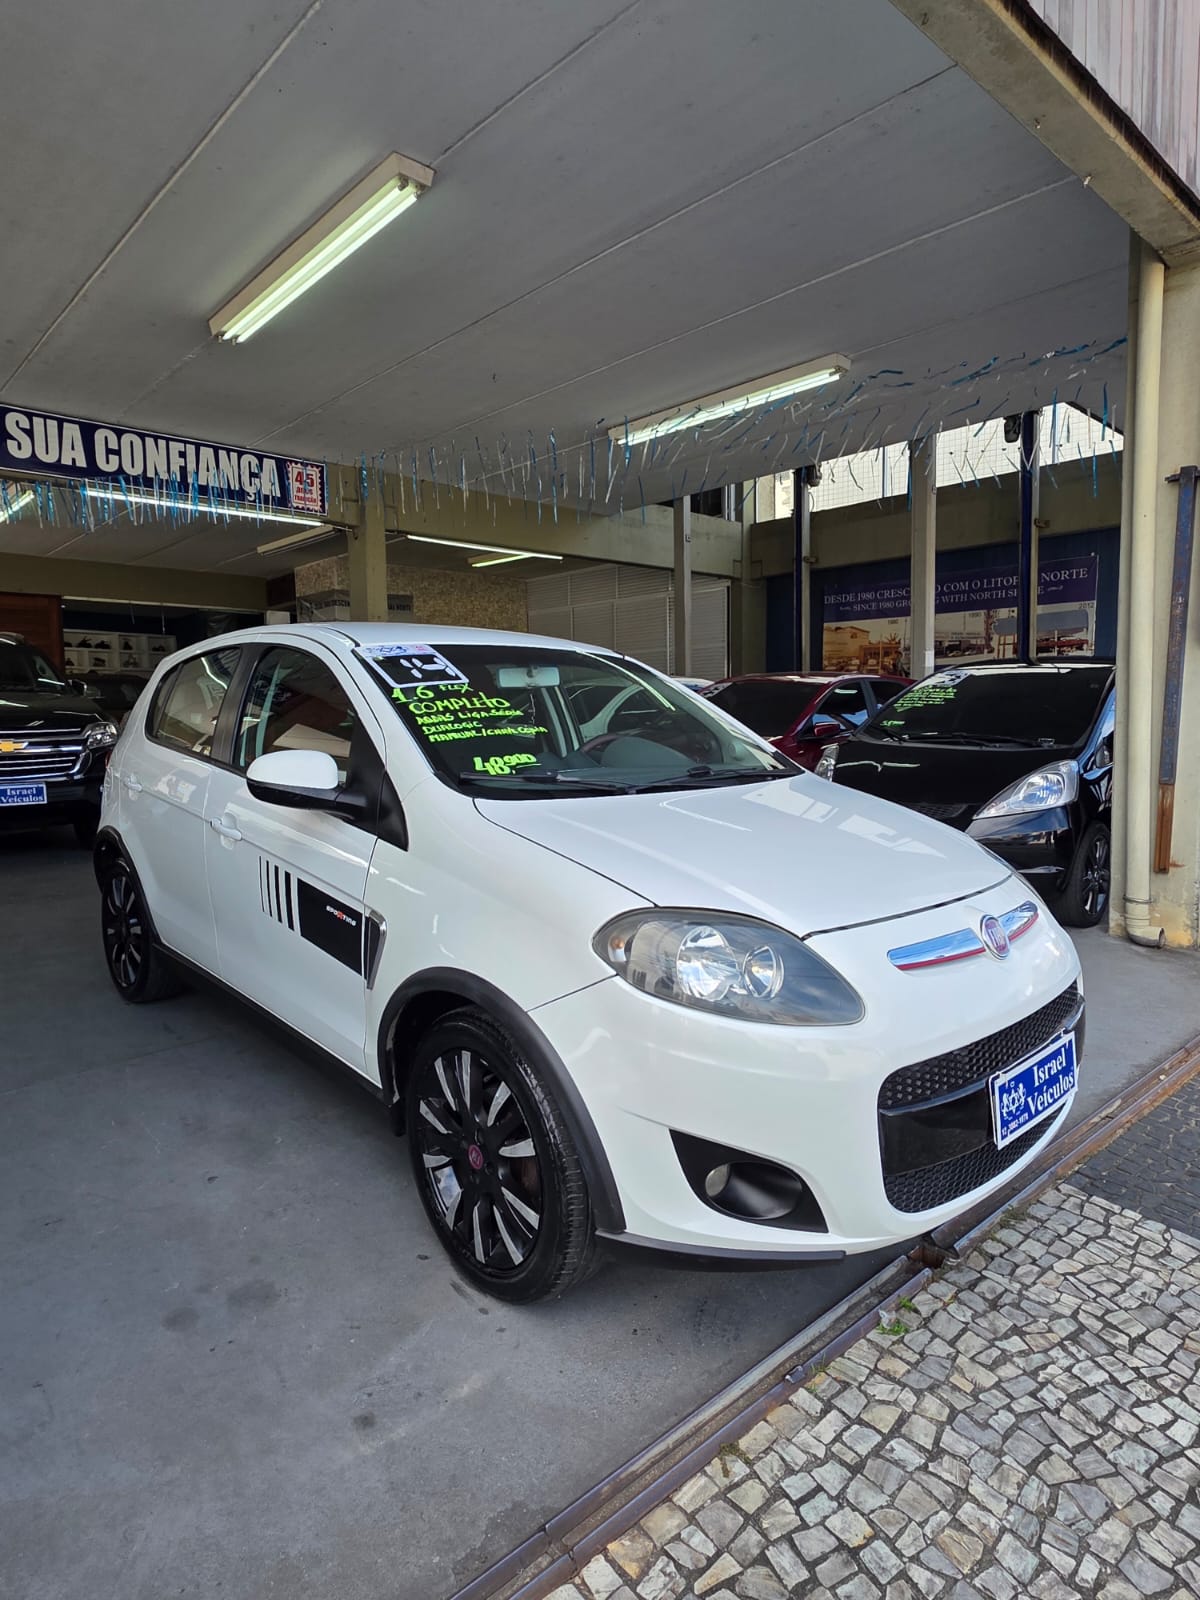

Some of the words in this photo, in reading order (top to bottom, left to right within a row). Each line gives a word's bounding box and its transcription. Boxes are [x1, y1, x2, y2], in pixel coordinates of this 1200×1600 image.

[4, 411, 87, 468] SUA
[94, 428, 281, 500] CONFIANÇA
[295, 471, 315, 488] 45
[824, 592, 856, 605] DESDE
[857, 591, 876, 602] 1980
[943, 580, 969, 592] COM
[972, 579, 981, 590] O
[1041, 567, 1089, 583] NORTE
[853, 602, 877, 612] SINCE
[879, 601, 895, 609] 1980
[940, 594, 968, 604] WITH
[969, 590, 1006, 601] NORTH
[391, 685, 435, 703] 1.6
[408, 691, 511, 714] COMPLETO
[1, 795, 44, 803] Veículos
[7, 787, 37, 796] Israel
[1033, 1047, 1067, 1087] Israel
[1026, 1071, 1074, 1115] Veículos
